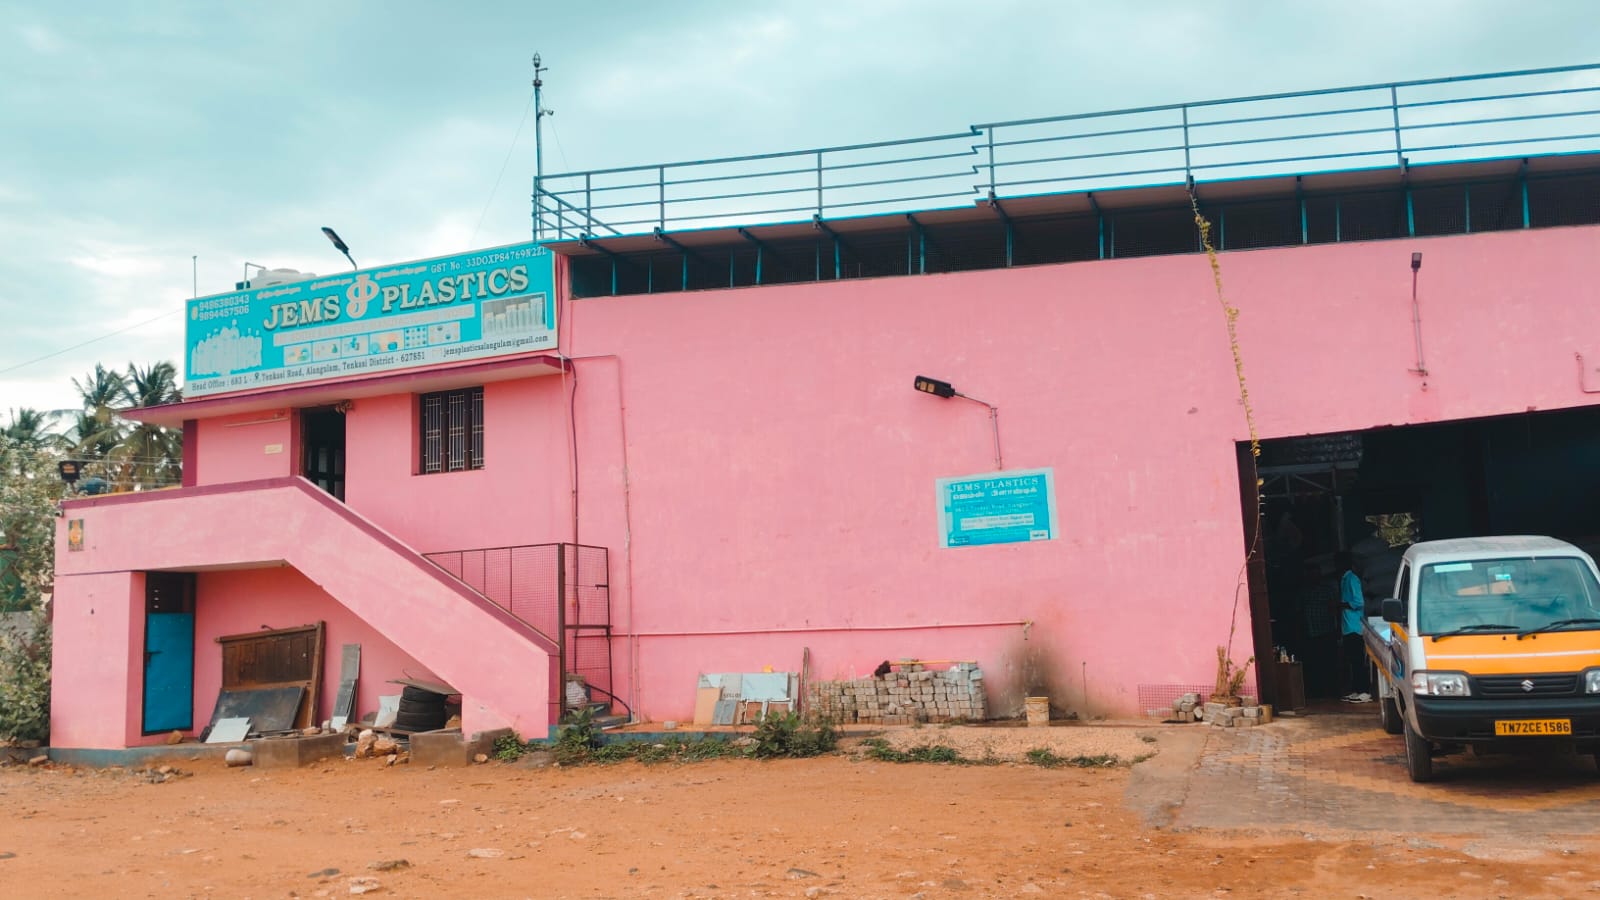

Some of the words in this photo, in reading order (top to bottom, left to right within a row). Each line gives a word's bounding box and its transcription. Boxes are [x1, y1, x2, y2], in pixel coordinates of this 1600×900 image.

[431, 263, 447, 273] GST
[263, 295, 341, 330] JEMS
[381, 265, 529, 312] PLASTICS
[191, 380, 207, 391] Head
[208, 378, 225, 390] Office
[261, 371, 285, 381] Tenkasi
[342, 360, 367, 370] Tenkasi
[369, 356, 395, 367] District
[951, 482, 981, 493] JEMS
[984, 477, 1039, 489] PLASTICS
